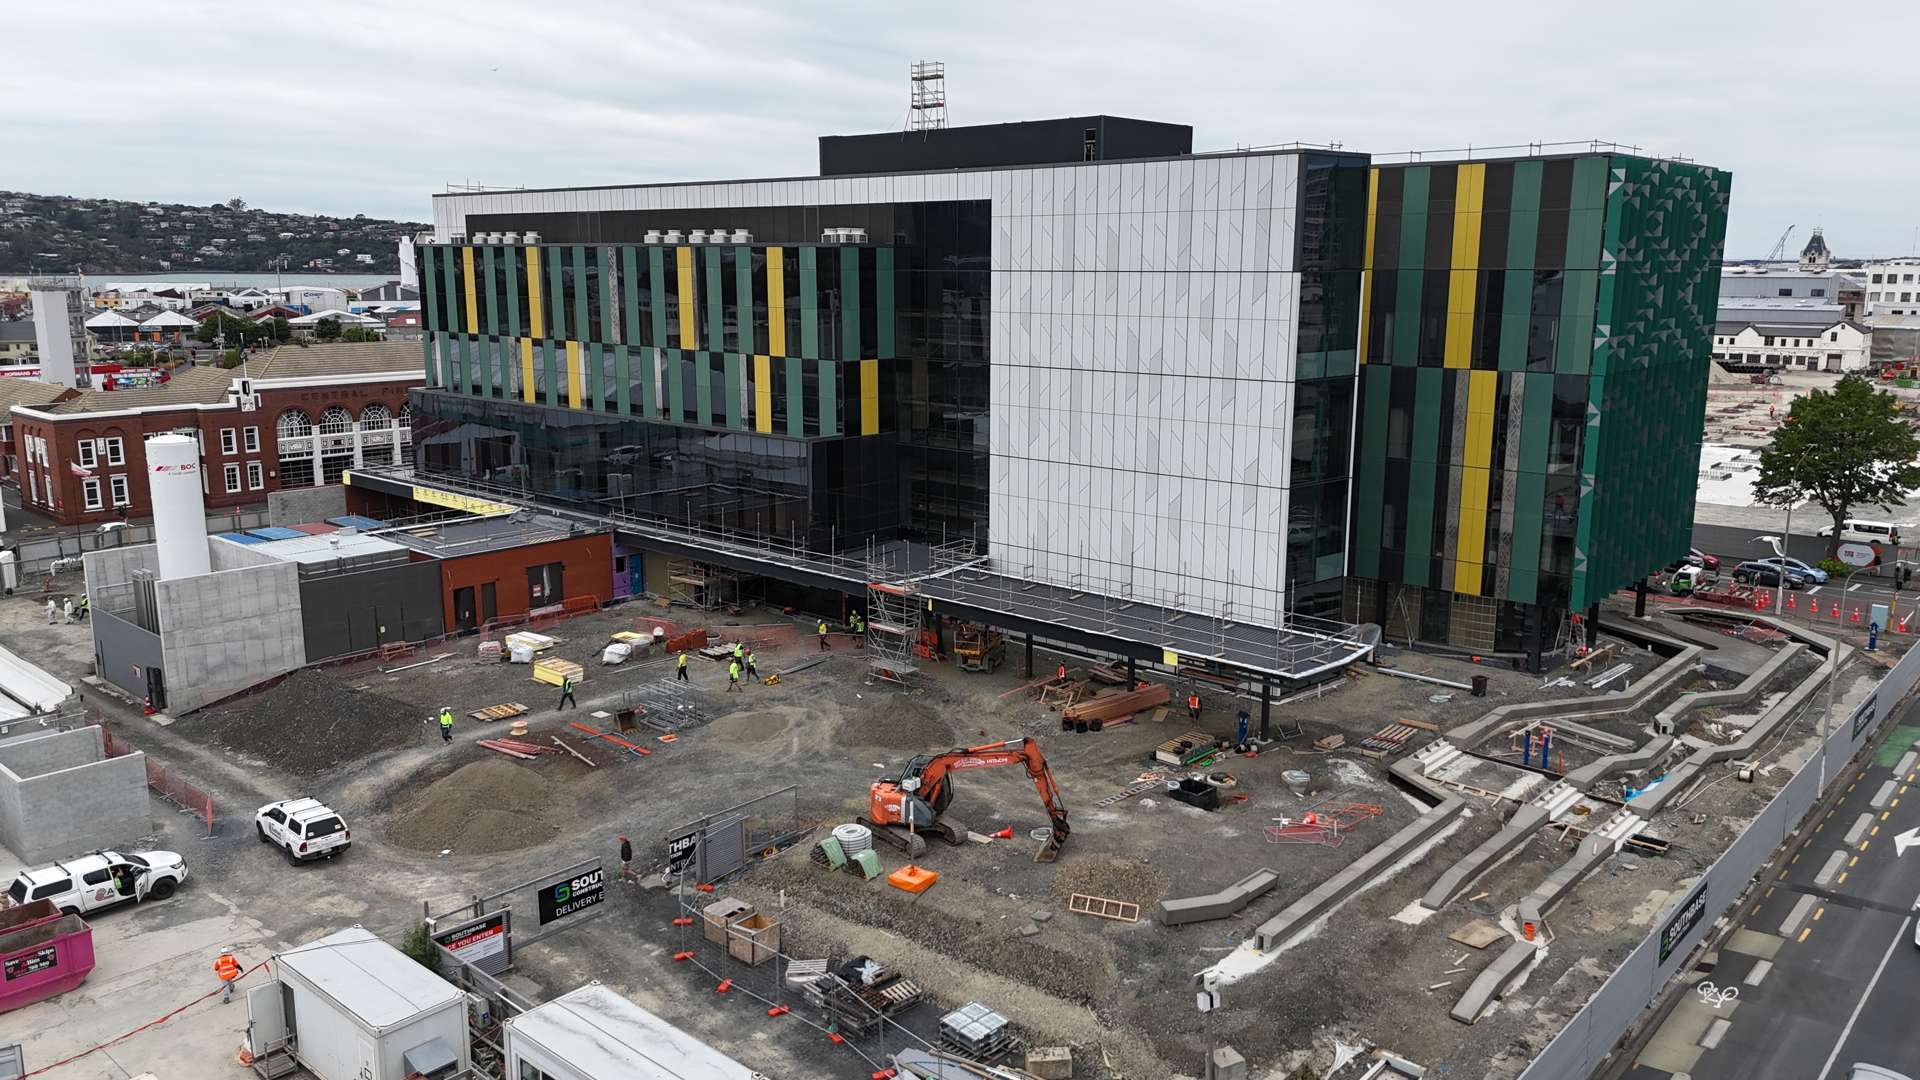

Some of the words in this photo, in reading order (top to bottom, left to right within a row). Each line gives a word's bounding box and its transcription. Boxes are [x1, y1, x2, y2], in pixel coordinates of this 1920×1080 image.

[301, 389, 368, 401] CENTRAL
[180, 462, 196, 471] BOC
[556, 893, 598, 917] DELIVERY
[1668, 890, 1708, 943] SOUTHBASE
[451, 922, 487, 940] SOUTHBASE
[458, 938, 472, 948] YOU
[472, 929, 494, 942] ENTER
